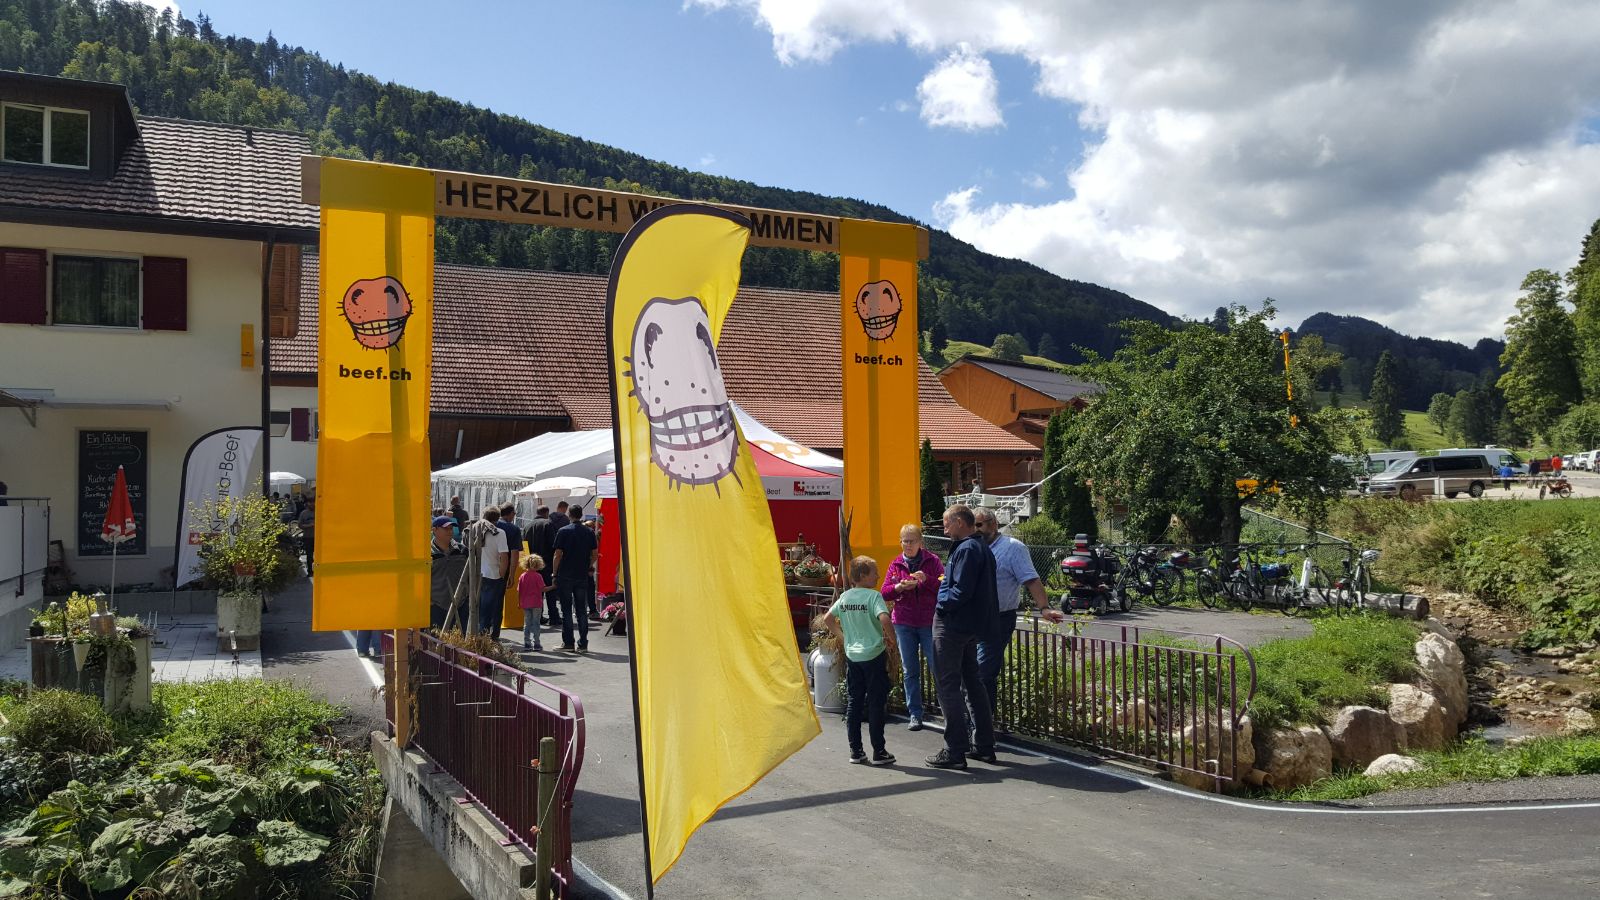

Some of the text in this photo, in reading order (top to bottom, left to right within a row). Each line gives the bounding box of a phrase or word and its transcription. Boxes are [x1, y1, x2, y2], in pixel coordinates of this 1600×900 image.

[446, 179, 833, 245] HERZLICH WMMEN
[854, 352, 903, 366] beef.ch
[339, 364, 412, 381] beef.ch
